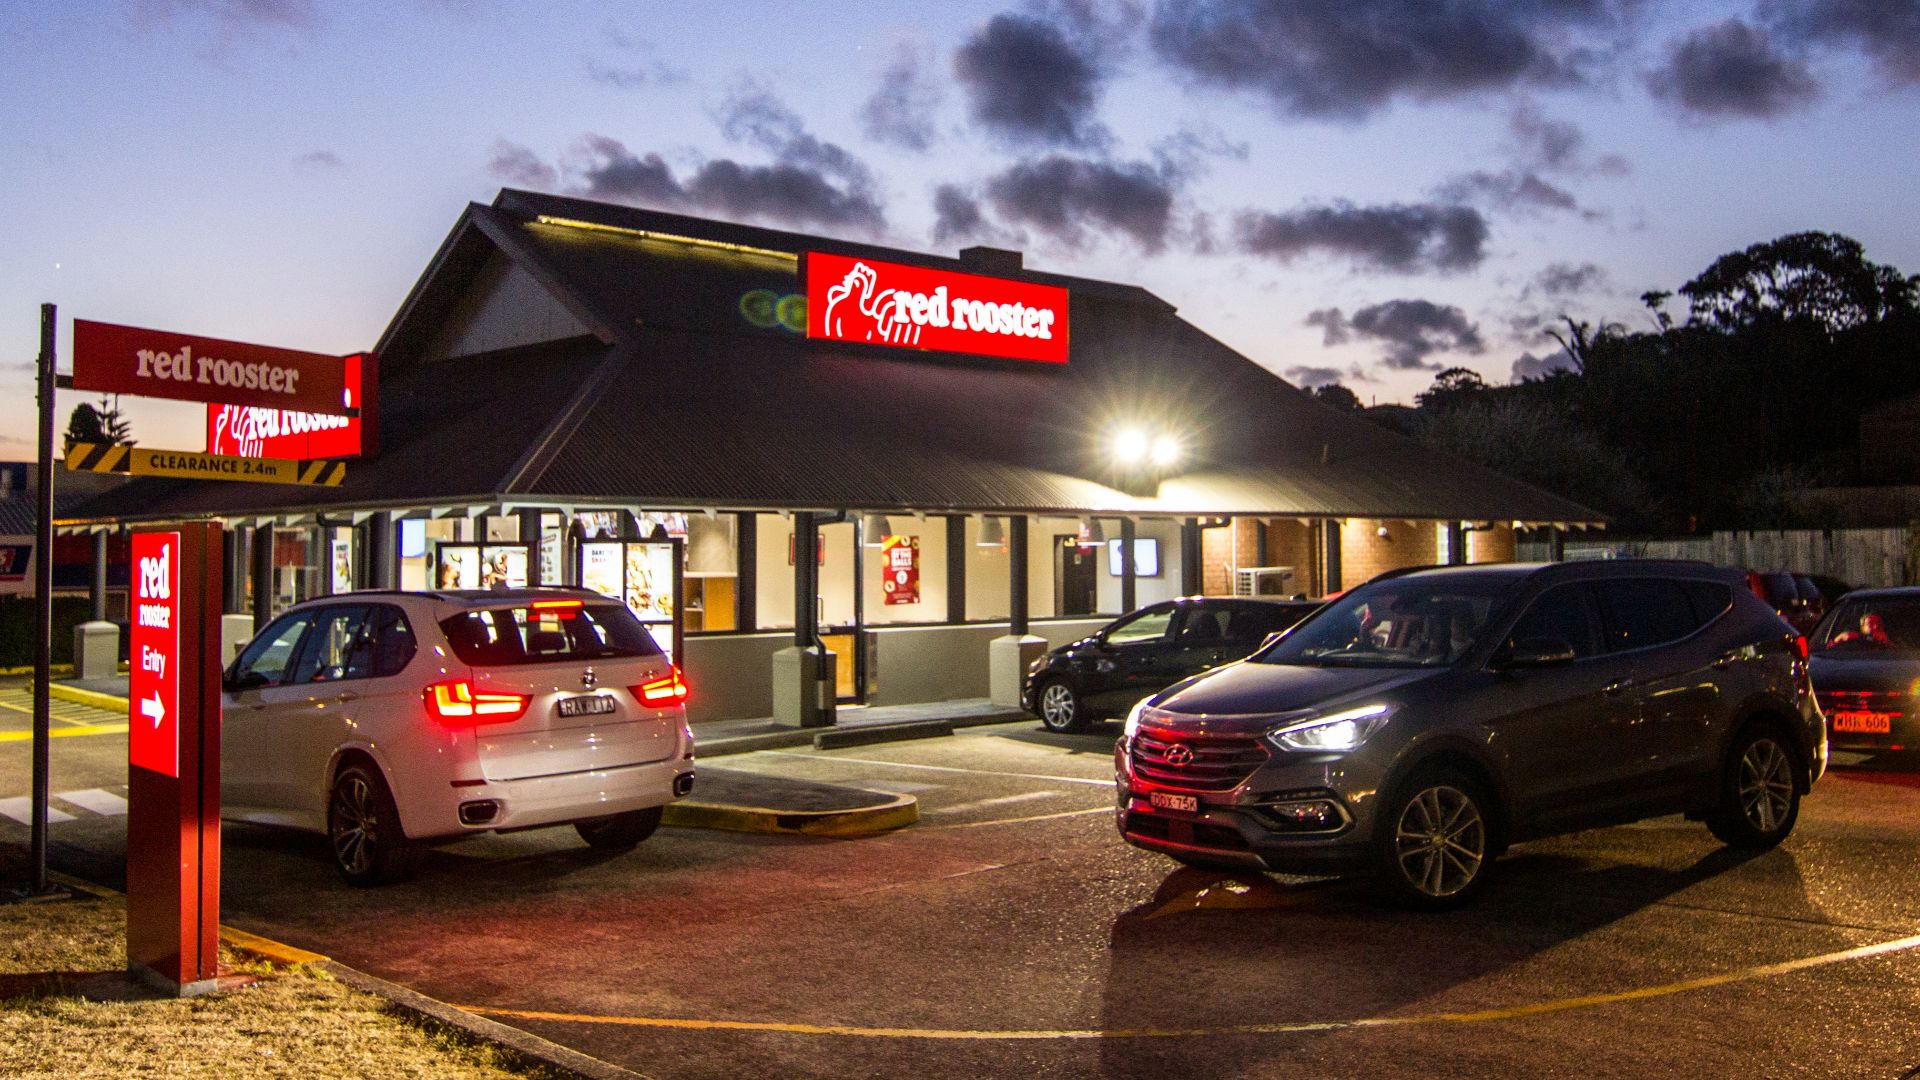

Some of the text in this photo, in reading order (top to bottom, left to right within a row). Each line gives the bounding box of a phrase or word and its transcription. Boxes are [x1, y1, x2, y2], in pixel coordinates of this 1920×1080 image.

[893, 286, 1054, 339] red rooster
[136, 345, 299, 394] red rooster
[150, 455, 277, 475] CLEARANCE 2.4m
[140, 543, 170, 599] red
[140, 604, 170, 629] rooster
[143, 645, 166, 680] Entry
